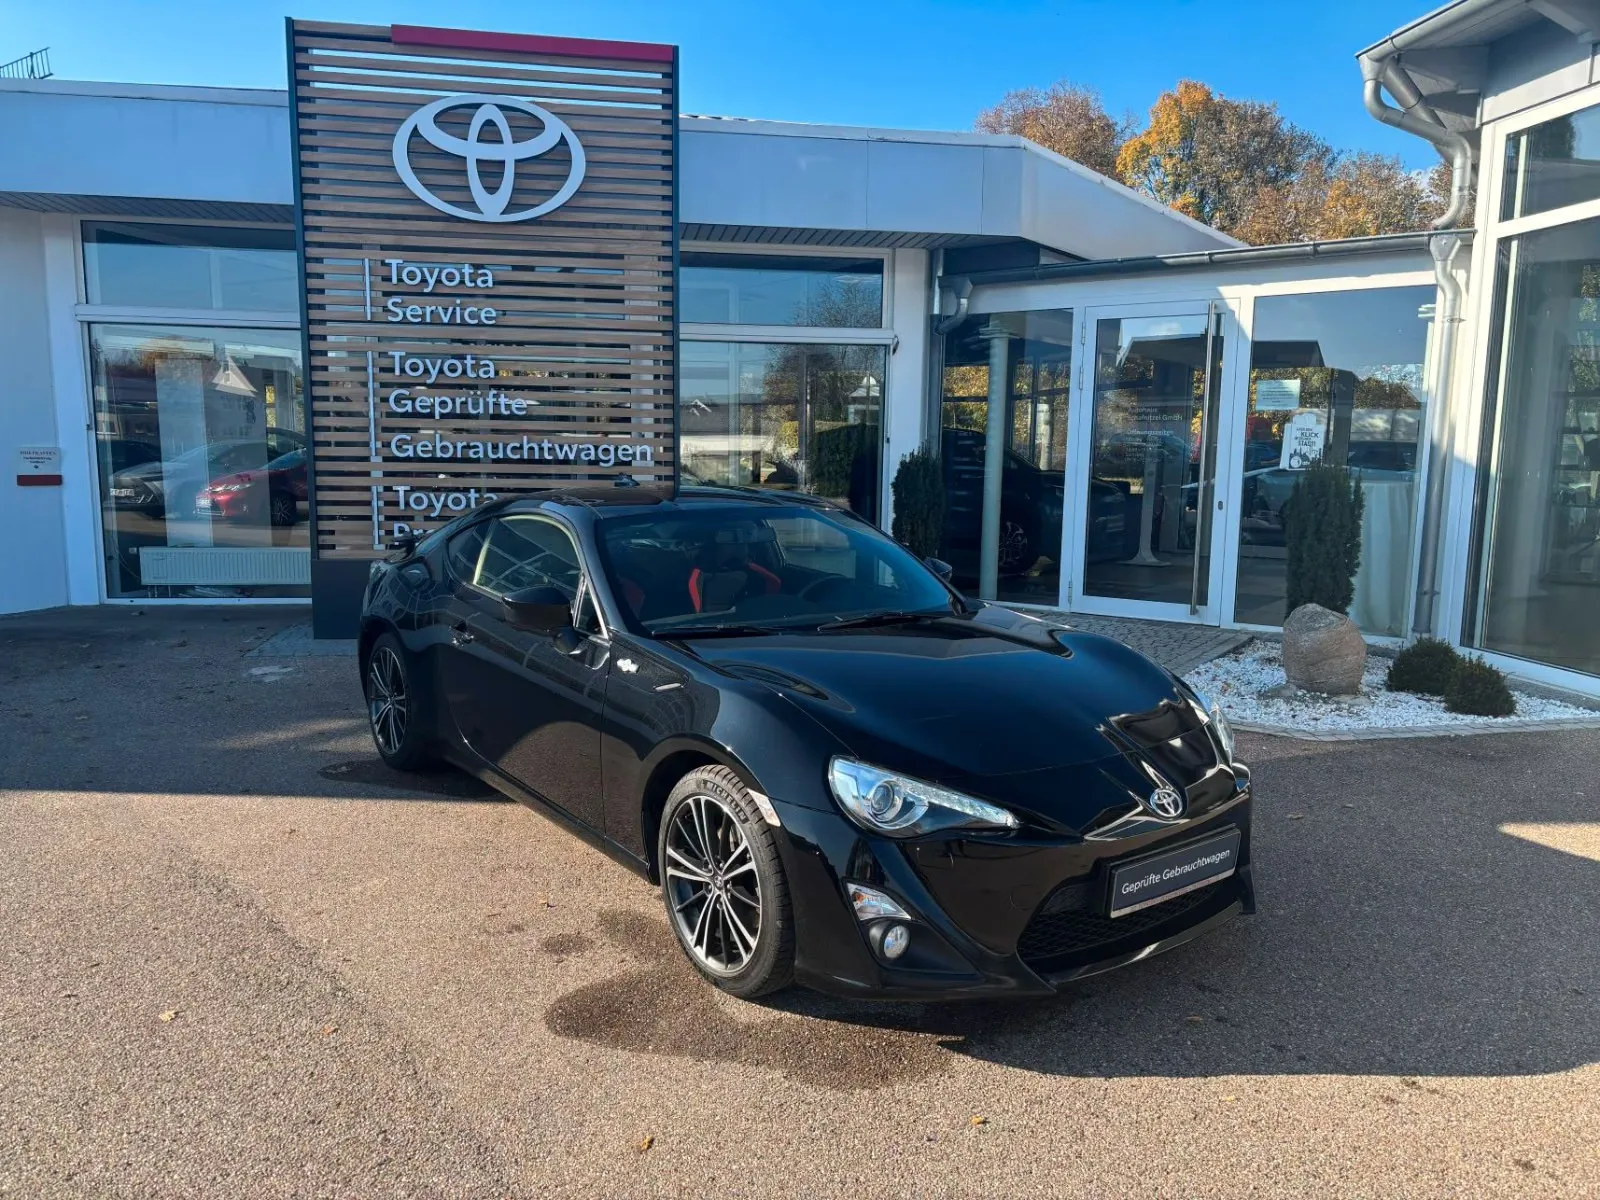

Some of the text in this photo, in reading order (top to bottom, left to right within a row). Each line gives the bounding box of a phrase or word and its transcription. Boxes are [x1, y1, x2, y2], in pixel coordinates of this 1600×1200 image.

[385, 258, 494, 292] Toyota
[386, 298, 497, 325] Service
[387, 351, 496, 384] Toyota
[388, 389, 528, 420] Geprüfte
[390, 434, 652, 467] Gebrauchtwagen
[705, 781, 747, 821] MICHELIN
[1121, 849, 1231, 895] Geprüfte Gebrauchtwagen
